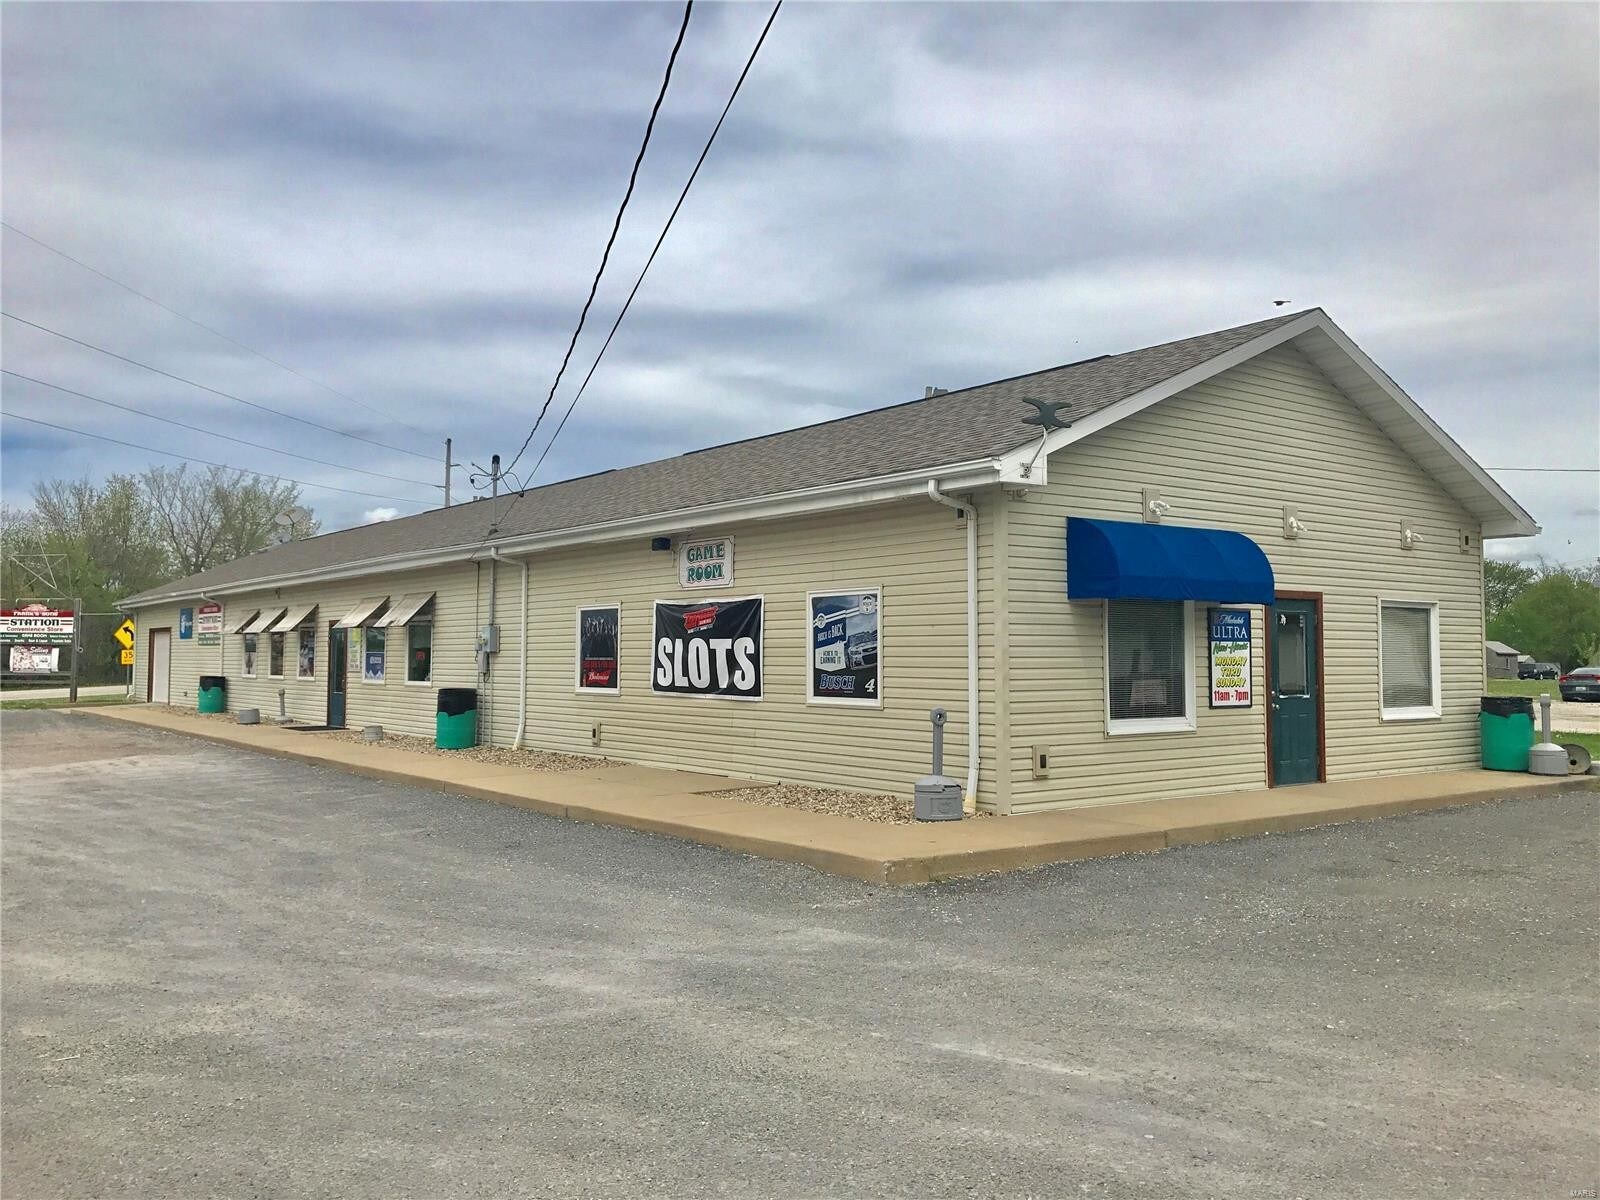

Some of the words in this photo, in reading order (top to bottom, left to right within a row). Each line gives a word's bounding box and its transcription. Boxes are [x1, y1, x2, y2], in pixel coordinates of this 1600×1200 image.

[686, 543, 725, 563] GAME
[686, 563, 724, 584] ROOM
[10, 618, 60, 626] STATION
[832, 623, 844, 638] BACK
[1213, 626, 1248, 638] ULTRA
[123, 651, 133, 659] 35
[1215, 656, 1247, 667] MONDAY
[657, 637, 755, 690] SLOTS
[1221, 667, 1241, 677] THRU
[820, 674, 855, 690] BUSCH
[864, 678, 876, 693] 4
[1216, 677, 1246, 688] SUNDAY
[1213, 690, 1230, 702] 11am
[1234, 689, 1249, 702] 7pm
